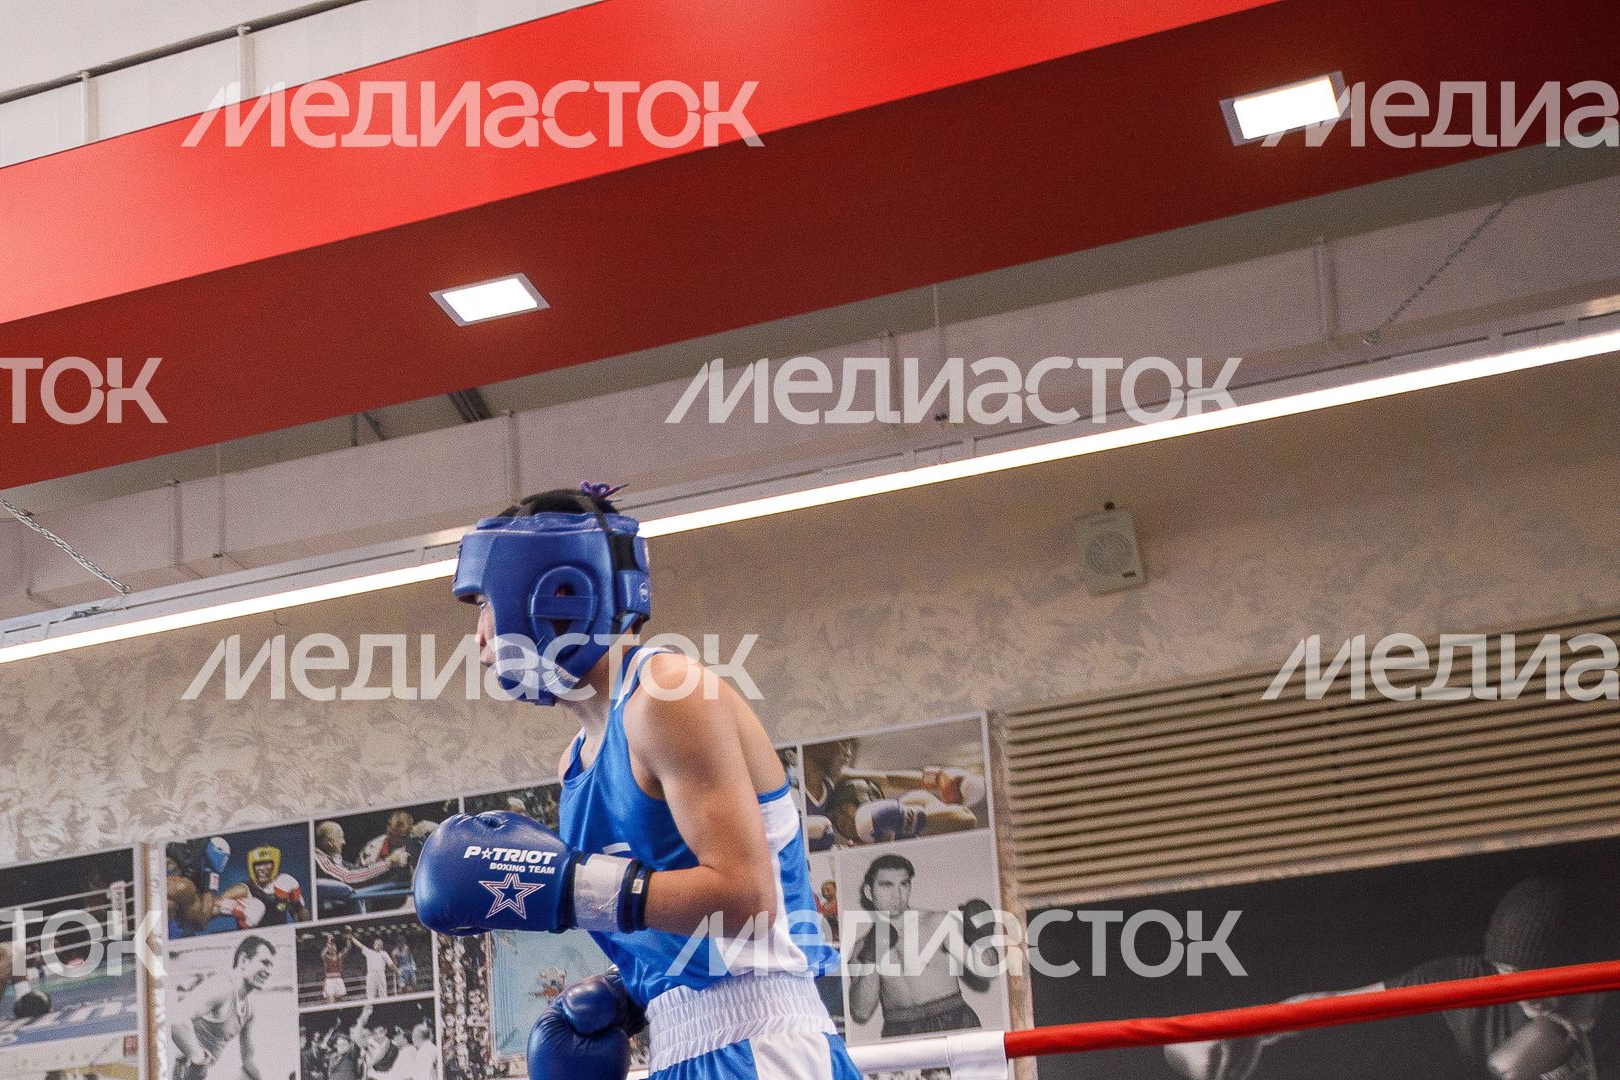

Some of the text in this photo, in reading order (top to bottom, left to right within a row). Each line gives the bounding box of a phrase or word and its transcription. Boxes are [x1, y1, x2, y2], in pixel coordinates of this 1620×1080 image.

[463, 845, 558, 865] PTRIOT
[489, 862, 555, 875] BOXING TEAM
